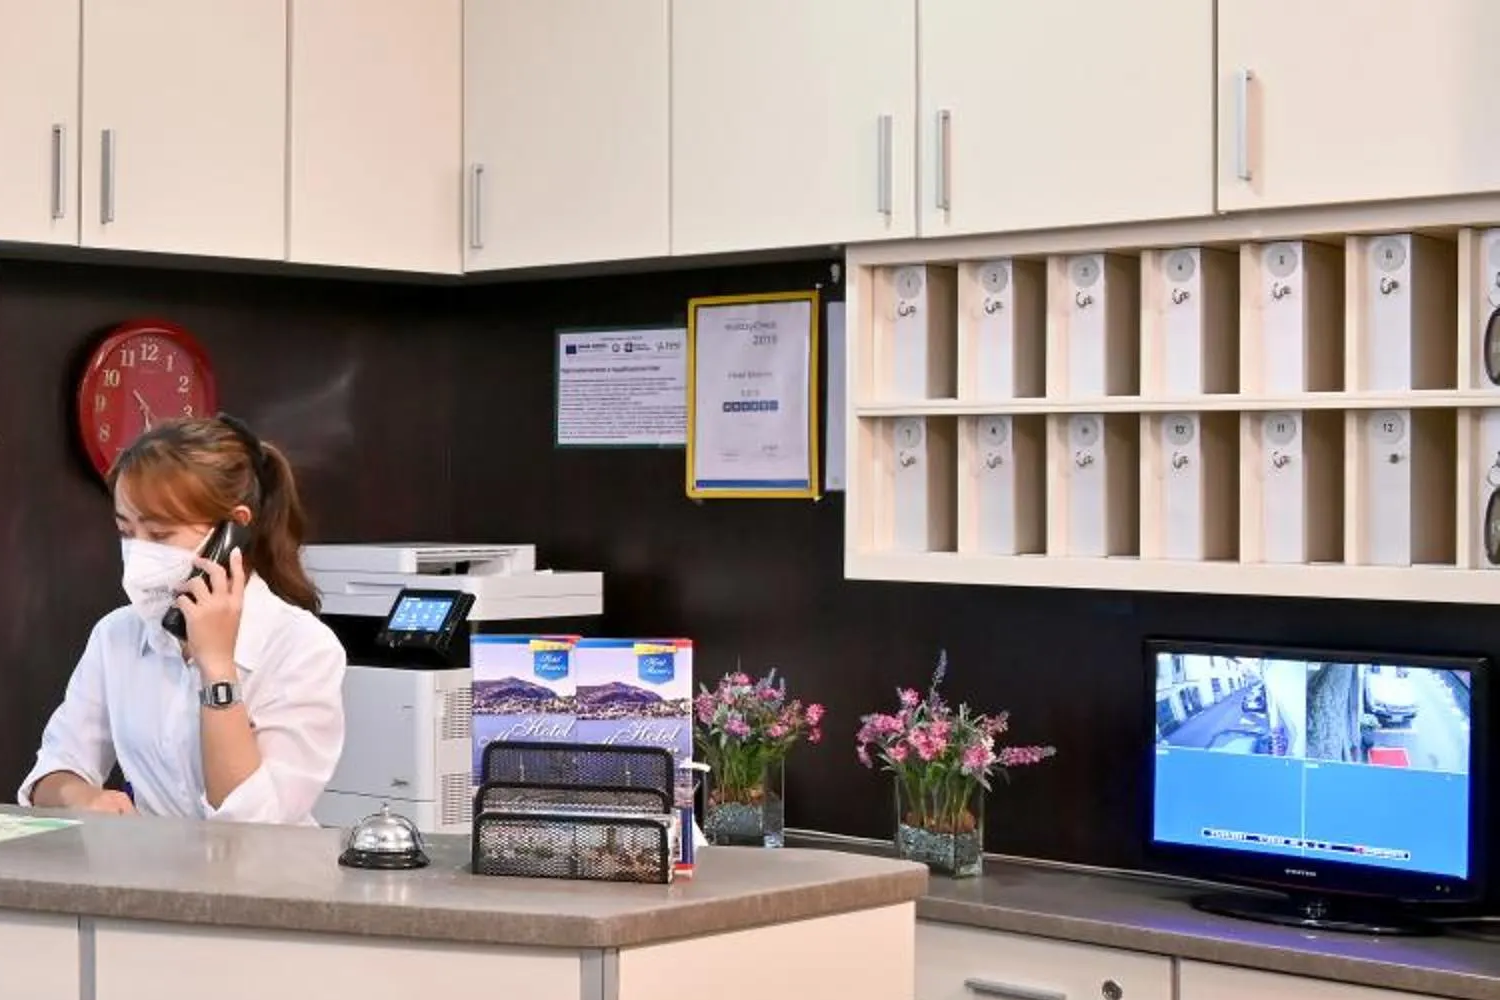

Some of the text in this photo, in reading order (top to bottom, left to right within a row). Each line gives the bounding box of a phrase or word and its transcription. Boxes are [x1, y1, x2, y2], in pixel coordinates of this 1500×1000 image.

[120, 348, 135, 367] 11
[140, 343, 159, 361] 12
[165, 354, 174, 372] 1
[103, 369, 120, 387] 10
[178, 375, 190, 393] 2
[94, 394, 106, 412] 9
[183, 405, 193, 418] 3
[99, 424, 110, 442] 8
[1277, 423, 1286, 433] 11
[1383, 423, 1394, 434] 12
[511, 714, 577, 738] Hotel
[616, 719, 682, 743] Hotel
